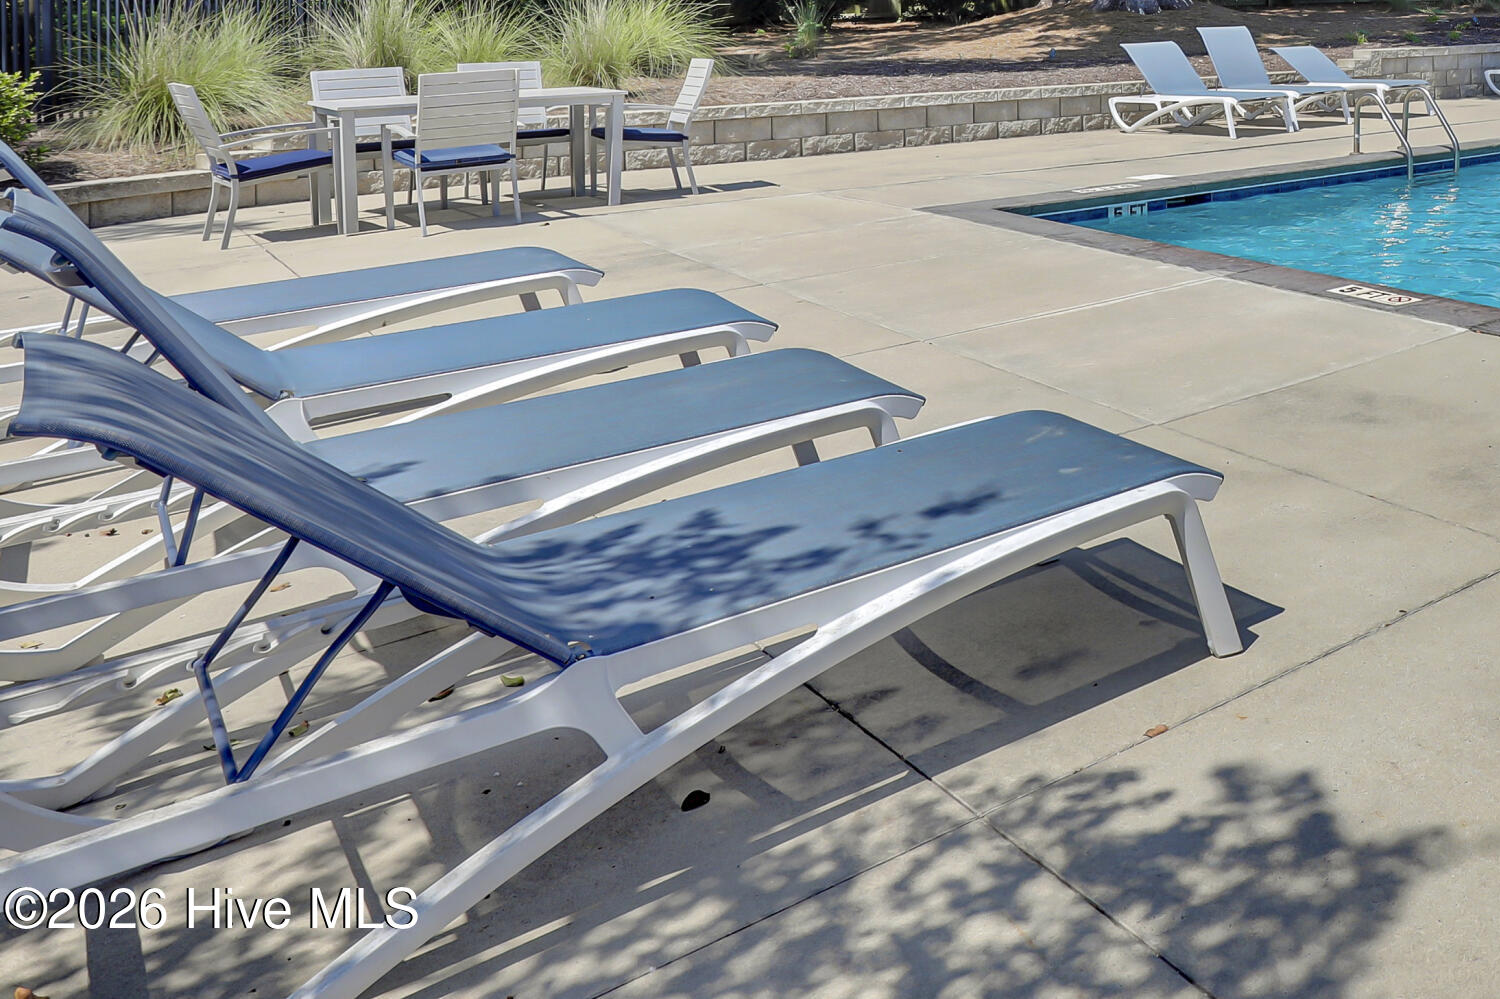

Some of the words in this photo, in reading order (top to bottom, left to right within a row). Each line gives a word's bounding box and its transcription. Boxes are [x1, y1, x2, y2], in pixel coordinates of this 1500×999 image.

[1130, 204, 1146, 216] FT
[1338, 286, 1363, 294] 5
[1356, 290, 1391, 299] FT
